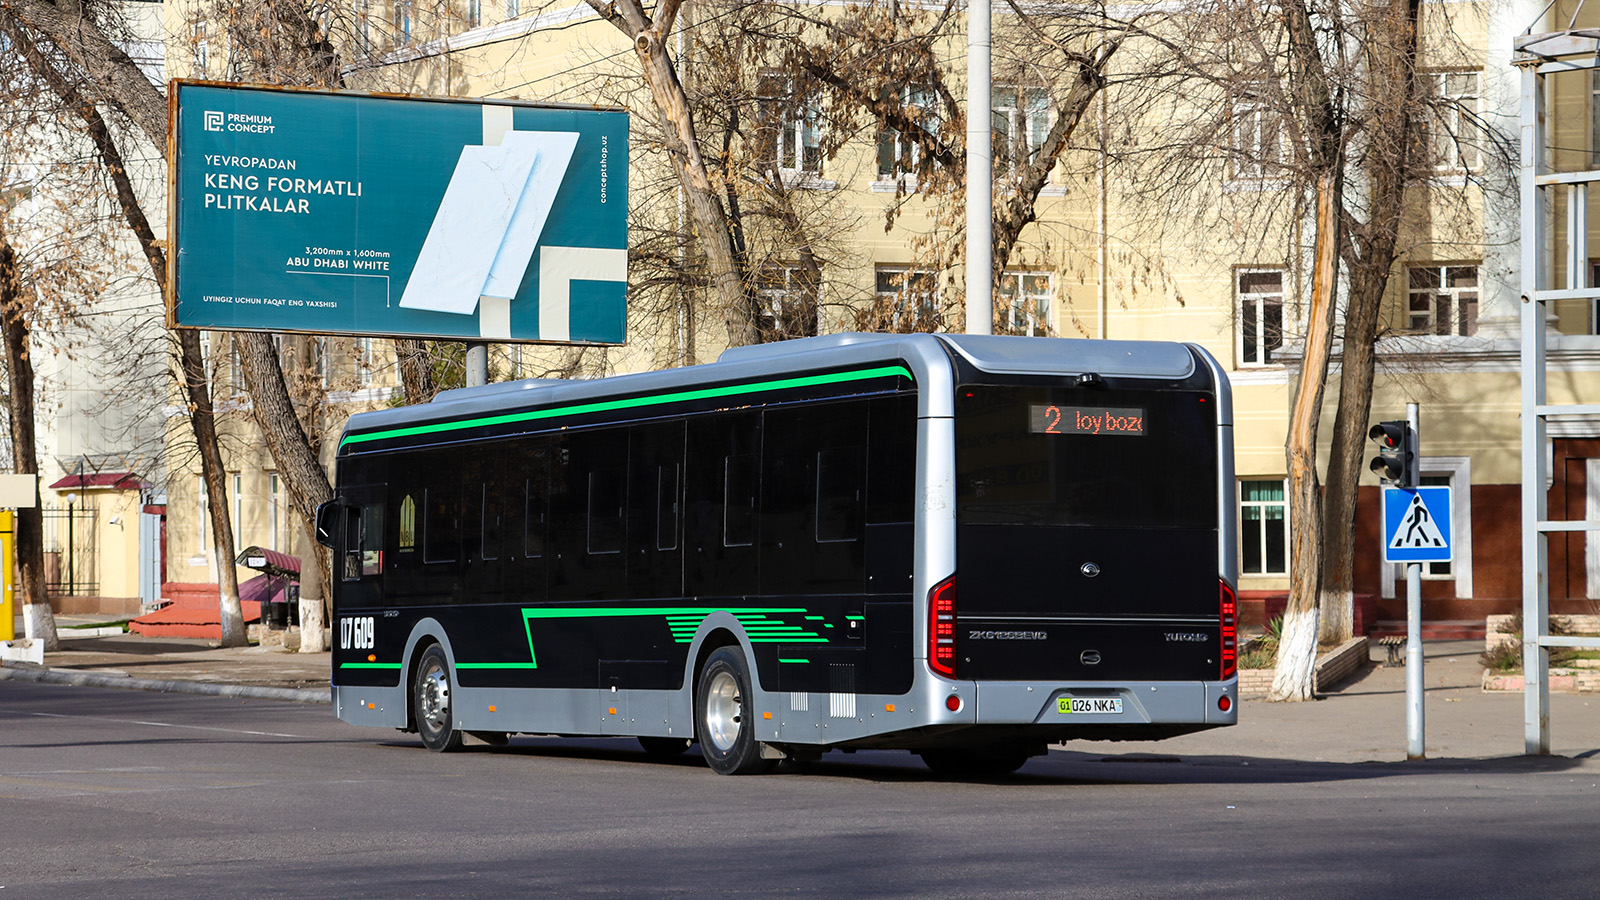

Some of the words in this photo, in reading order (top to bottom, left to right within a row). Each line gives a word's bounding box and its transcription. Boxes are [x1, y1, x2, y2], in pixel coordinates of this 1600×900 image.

[227, 113, 272, 125] PREMIUM
[227, 123, 276, 134] CONCEPT
[204, 154, 296, 171] YEVROPADAN
[600, 135, 609, 204] conceptshop.uz
[204, 173, 259, 191] KENG
[267, 177, 362, 197] FORMATLI
[204, 193, 310, 214] PLITKALAR
[305, 246, 344, 256] 3,200mm
[353, 249, 390, 259] 1,600mm
[286, 257, 310, 267] ABU
[314, 258, 349, 269] DHABI
[352, 260, 390, 271] WHITE
[203, 295, 233, 304] UYINGIZ
[235, 296, 262, 305] UCHUN
[263, 298, 286, 307] FAQAT
[288, 299, 303, 307] ENG
[305, 300, 338, 308] YAXSHISI
[1044, 405, 1062, 434] 2
[1076, 410, 1102, 435] loy
[340, 617, 353, 650] 07
[354, 616, 375, 650] 609
[1163, 632, 1209, 642] YUTONG
[1060, 700, 1070, 711] 01
[1072, 699, 1092, 711] 026
[1094, 699, 1117, 711] NKA
